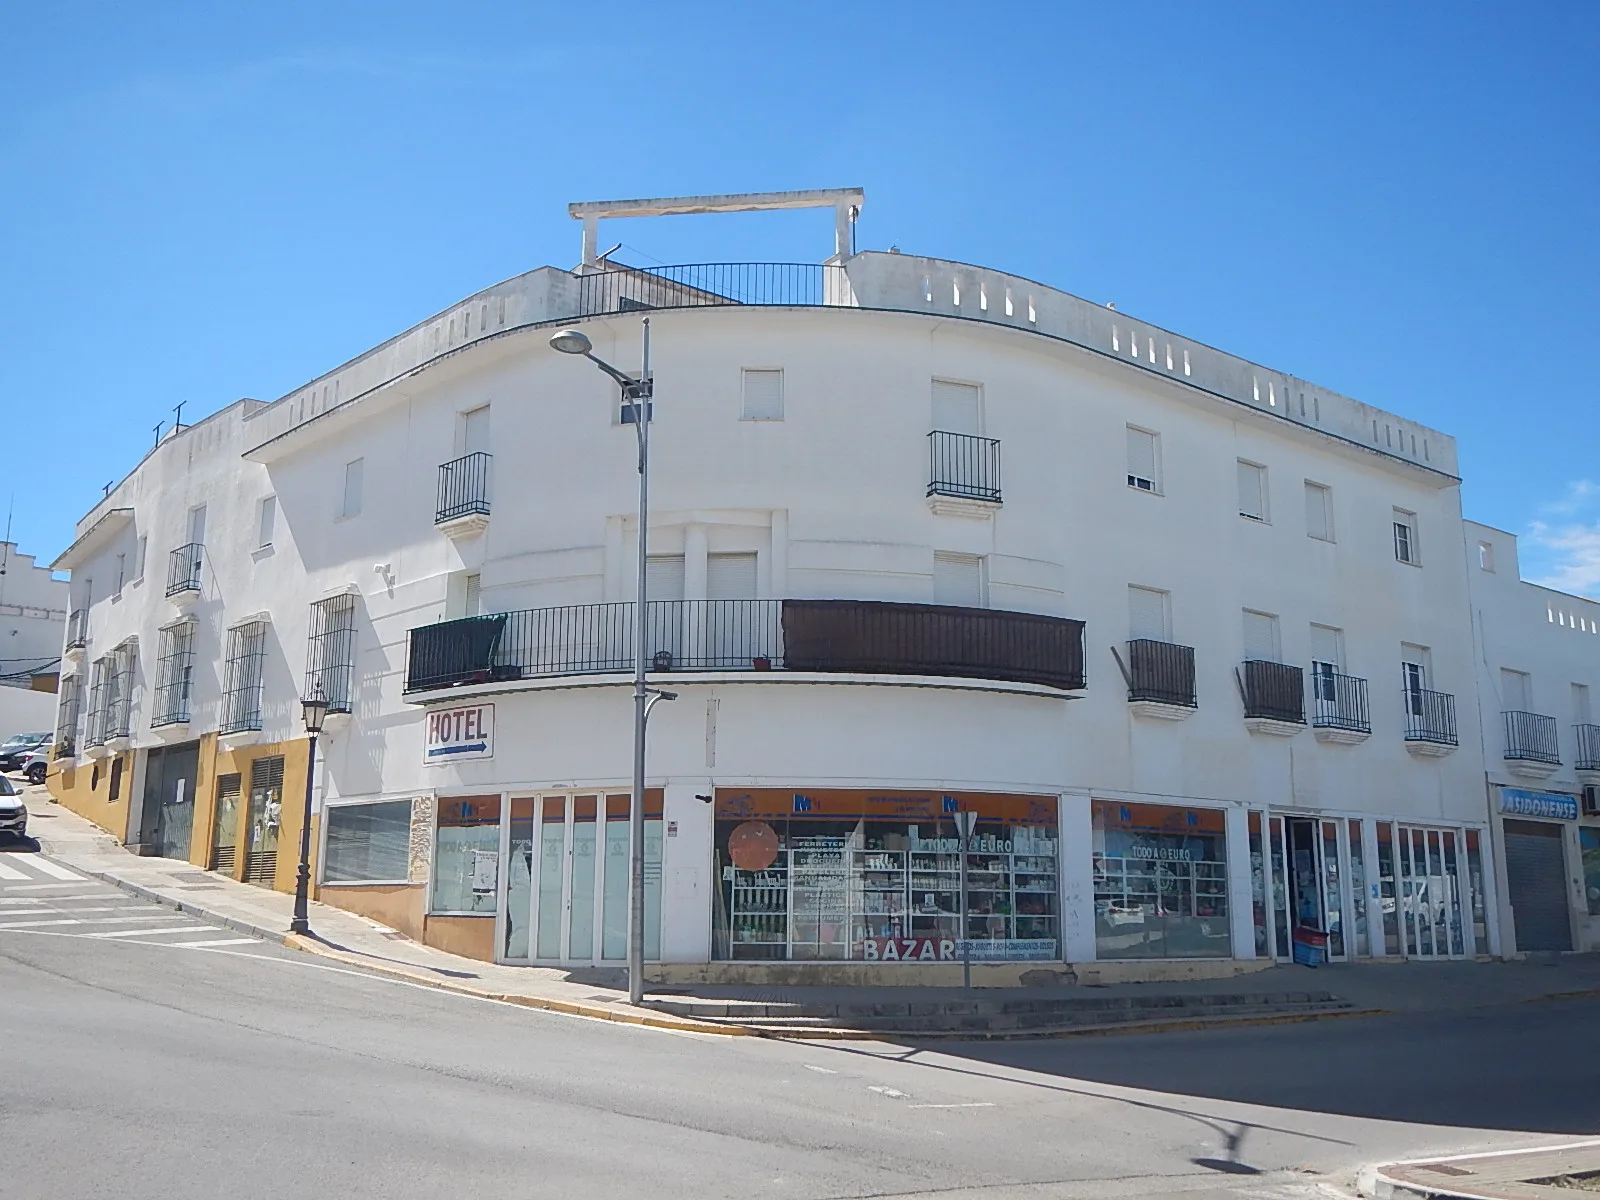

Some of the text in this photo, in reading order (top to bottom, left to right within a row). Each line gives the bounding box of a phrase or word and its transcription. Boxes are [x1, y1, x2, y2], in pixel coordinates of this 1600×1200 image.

[429, 708, 488, 745] HOTEL
[1505, 796, 1577, 819] ASIDONENSE
[980, 839, 1012, 852] EURO
[1132, 845, 1152, 859] TODO
[1167, 848, 1191, 860] EURO
[863, 939, 955, 962] BAZAR
